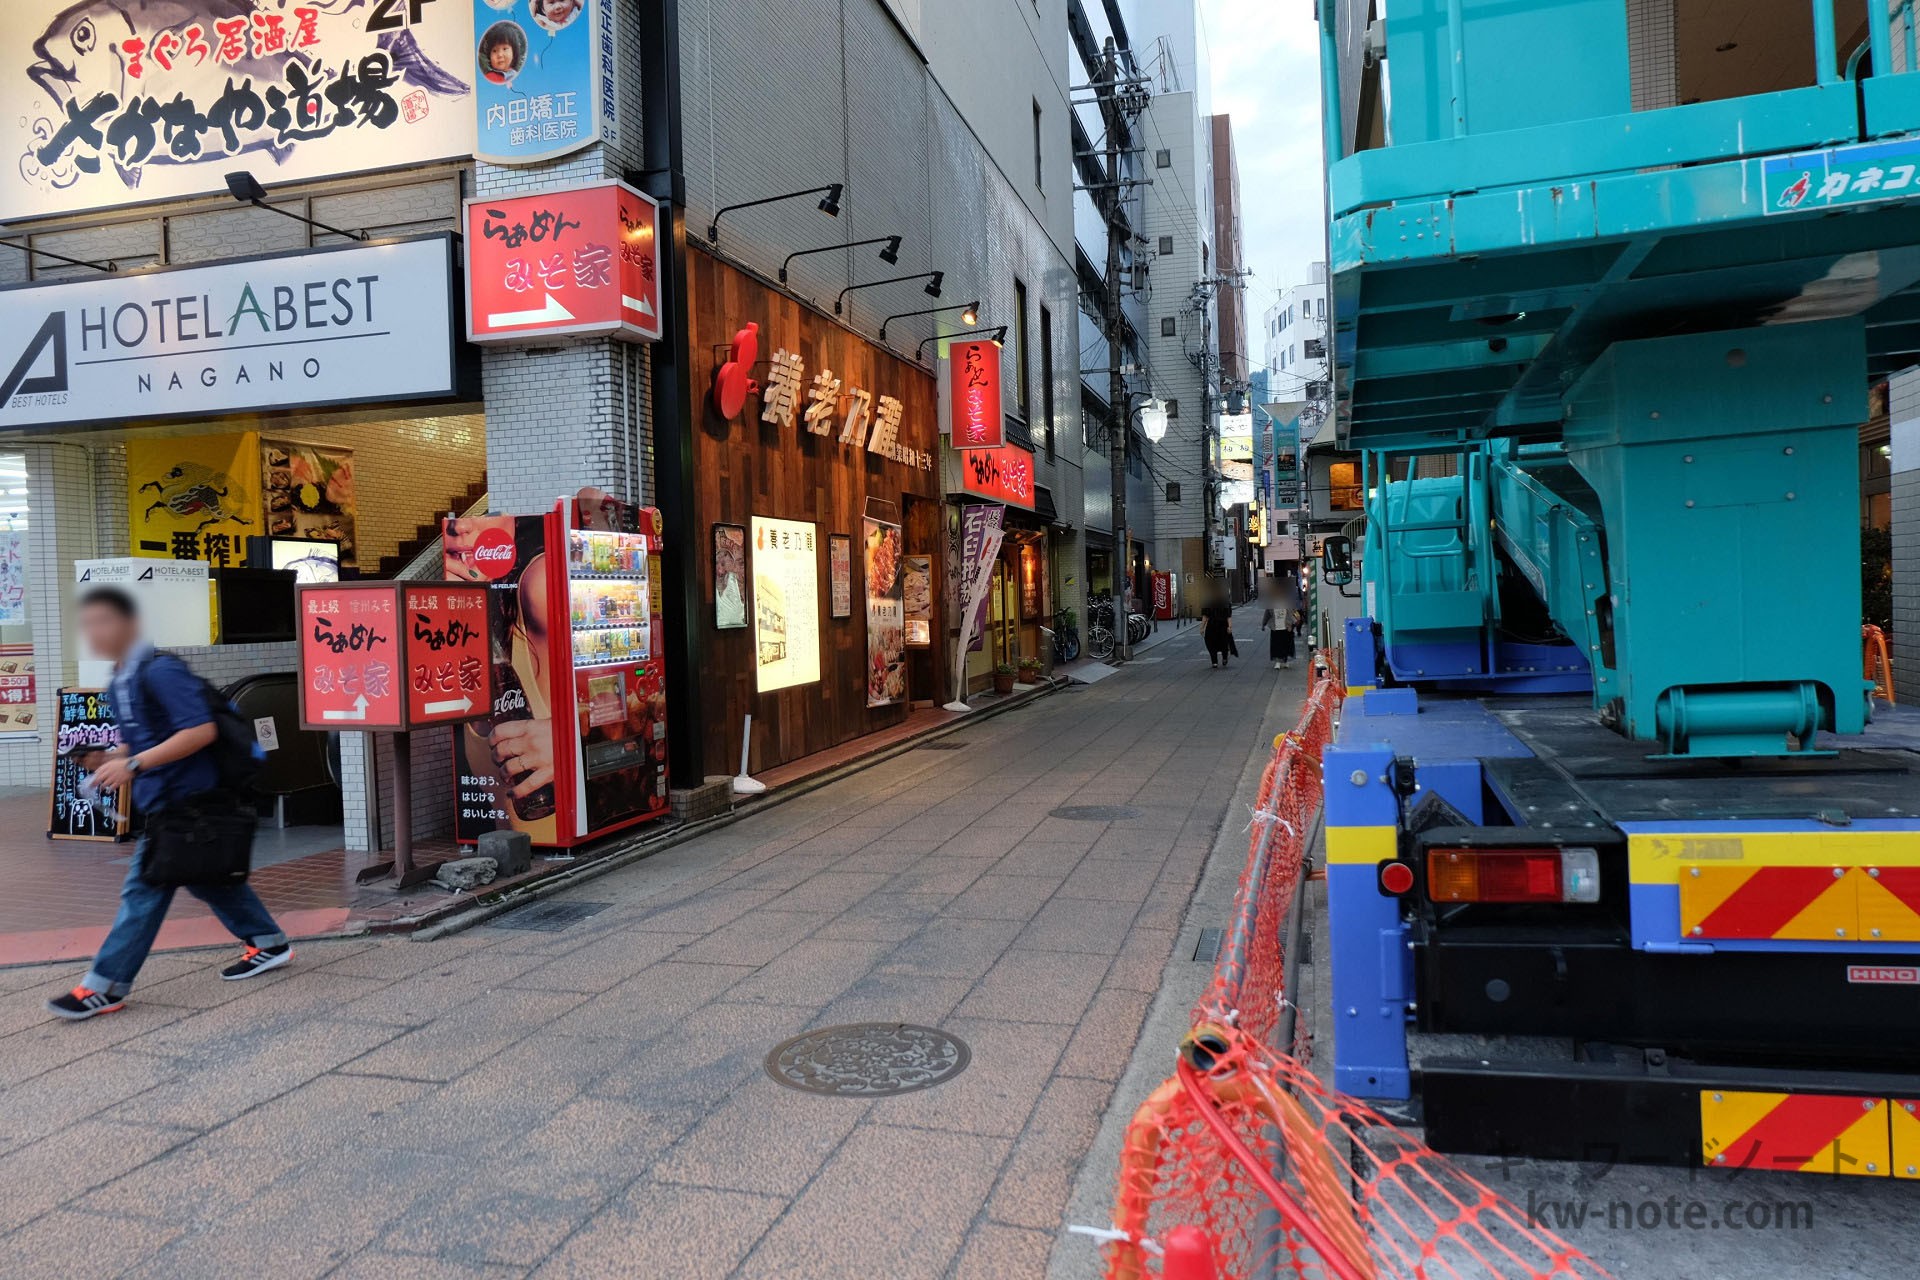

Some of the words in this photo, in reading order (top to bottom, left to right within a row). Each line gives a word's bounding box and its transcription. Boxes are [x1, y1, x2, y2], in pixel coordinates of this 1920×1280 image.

[122, 7, 321, 79] まぐろ居酒屋
[37, 53, 400, 174] さかなや道場
[487, 91, 578, 130] 内田矯正
[510, 120, 577, 146] 歯科医院
[504, 242, 612, 293] みそ家
[138, 357, 320, 394] NAGANO
[11, 395, 34, 408] BEST
[35, 393, 68, 407] HOTELS
[474, 544, 514, 561] Coca-Cola
[307, 599, 340, 614] 最上級
[408, 594, 439, 610] 最上級
[446, 595, 483, 610] 信州みそ
[413, 656, 483, 694] みそ家
[63, 704, 87, 722] 鮮魚
[462, 792, 496, 803] はじける
[463, 808, 510, 820] おいしさを。
[1853, 969, 1914, 980] HINO
